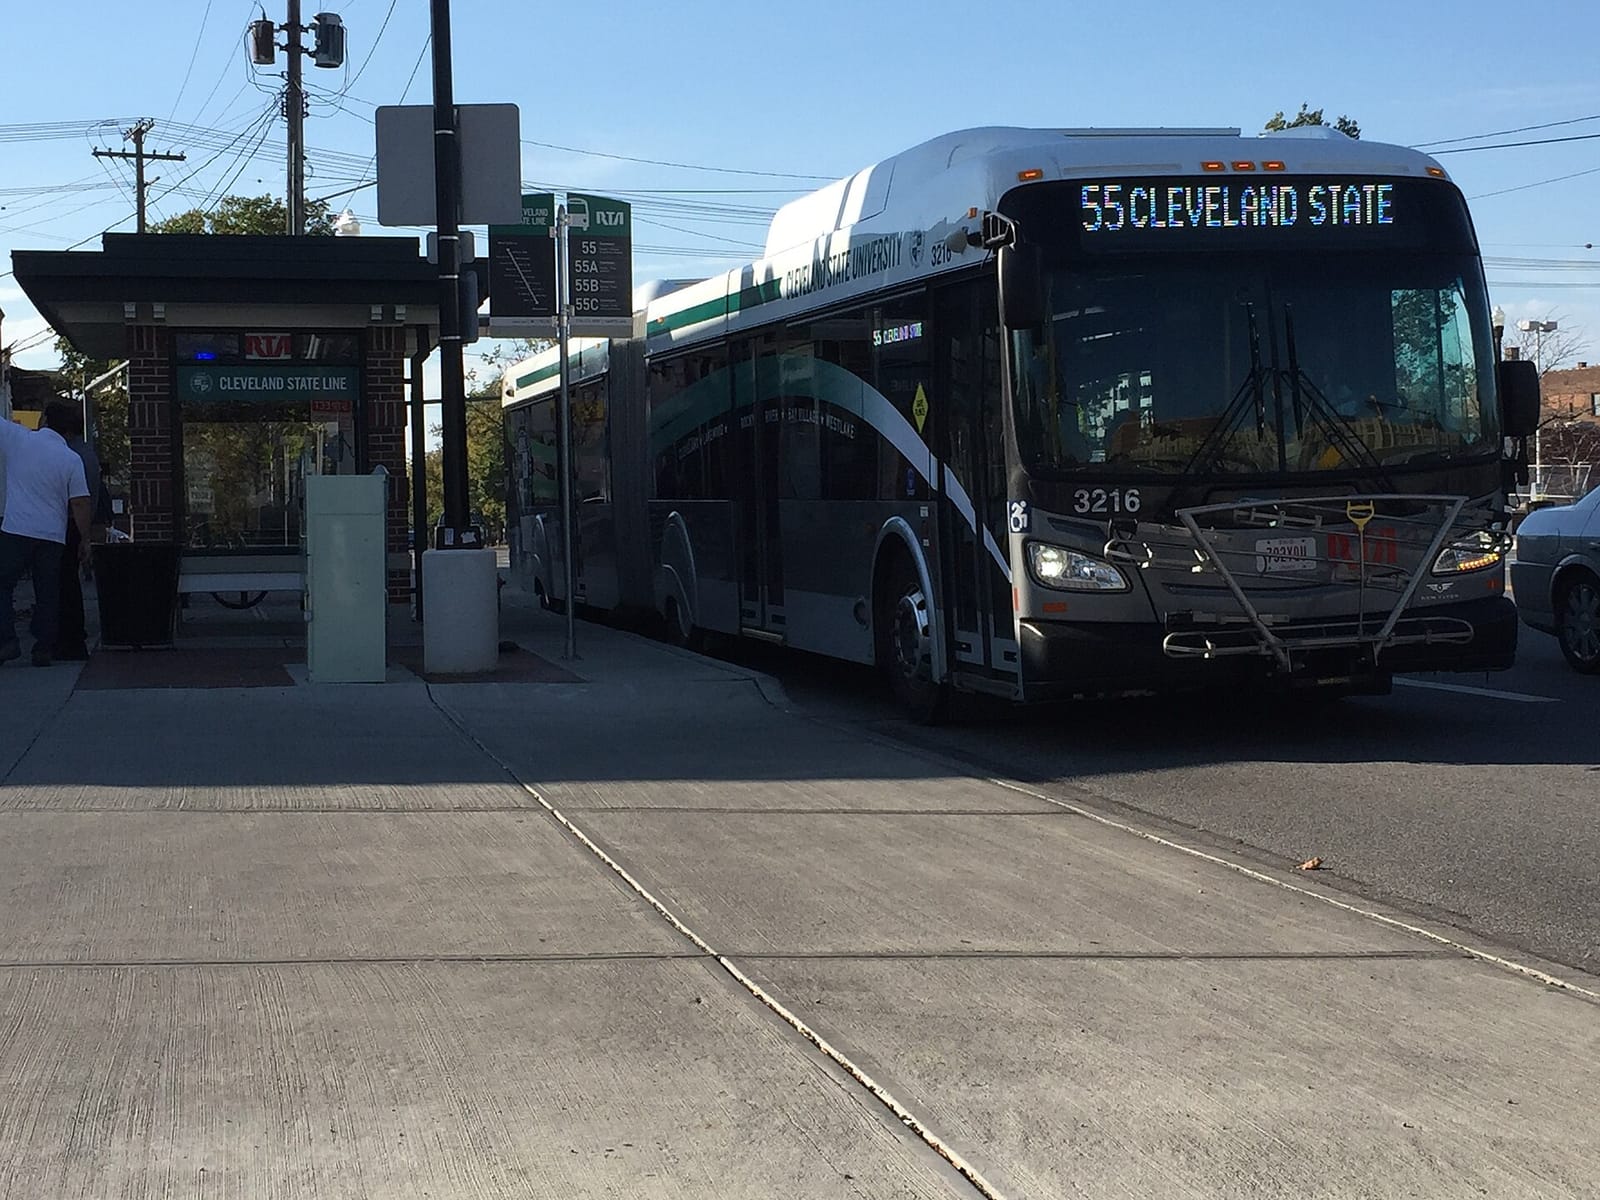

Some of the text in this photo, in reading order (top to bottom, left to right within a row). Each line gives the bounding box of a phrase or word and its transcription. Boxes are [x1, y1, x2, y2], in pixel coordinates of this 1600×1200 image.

[1081, 184, 1393, 231] 55 CLEVELAND STATE
[596, 211, 624, 226] RTA
[581, 241, 596, 254] 55
[575, 260, 598, 273] 55A
[786, 235, 902, 300] CLEVELAND STATE UNIVERSITY
[575, 279, 599, 292] 55B
[575, 298, 599, 311] 55C
[219, 377, 347, 390] CLEVELAND STATE LINE
[1073, 488, 1141, 513] 3216
